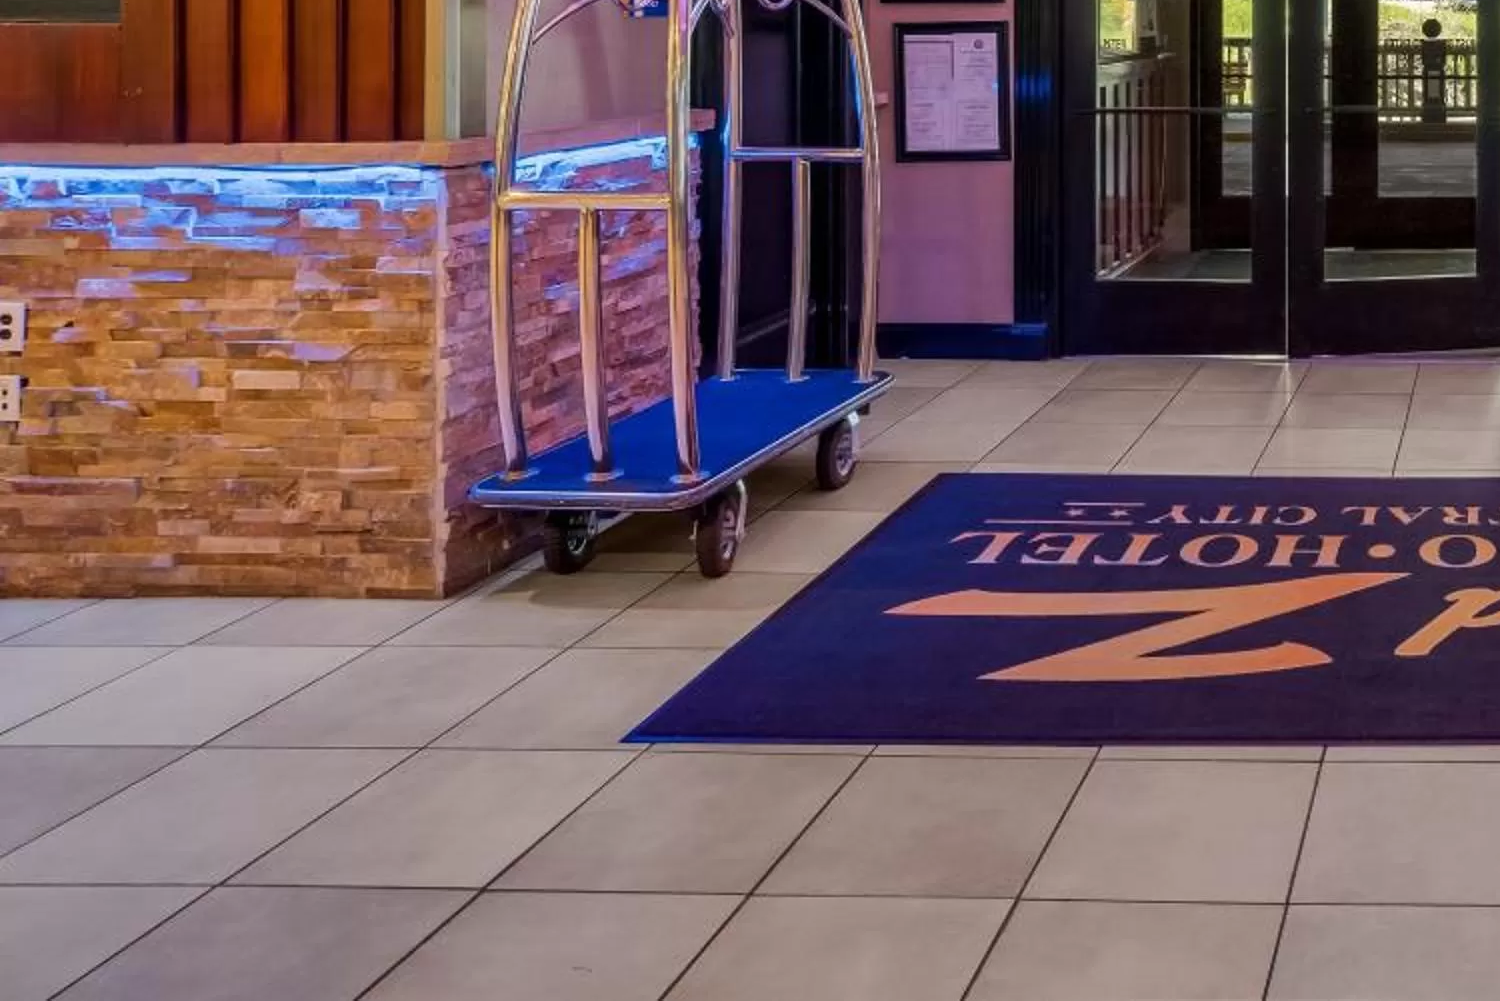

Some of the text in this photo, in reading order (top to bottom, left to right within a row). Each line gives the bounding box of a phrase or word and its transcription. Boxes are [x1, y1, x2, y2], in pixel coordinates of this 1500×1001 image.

[1146, 503, 1318, 527] CITY
[948, 530, 1349, 569] HOTEL
[882, 572, 1413, 682] Z
